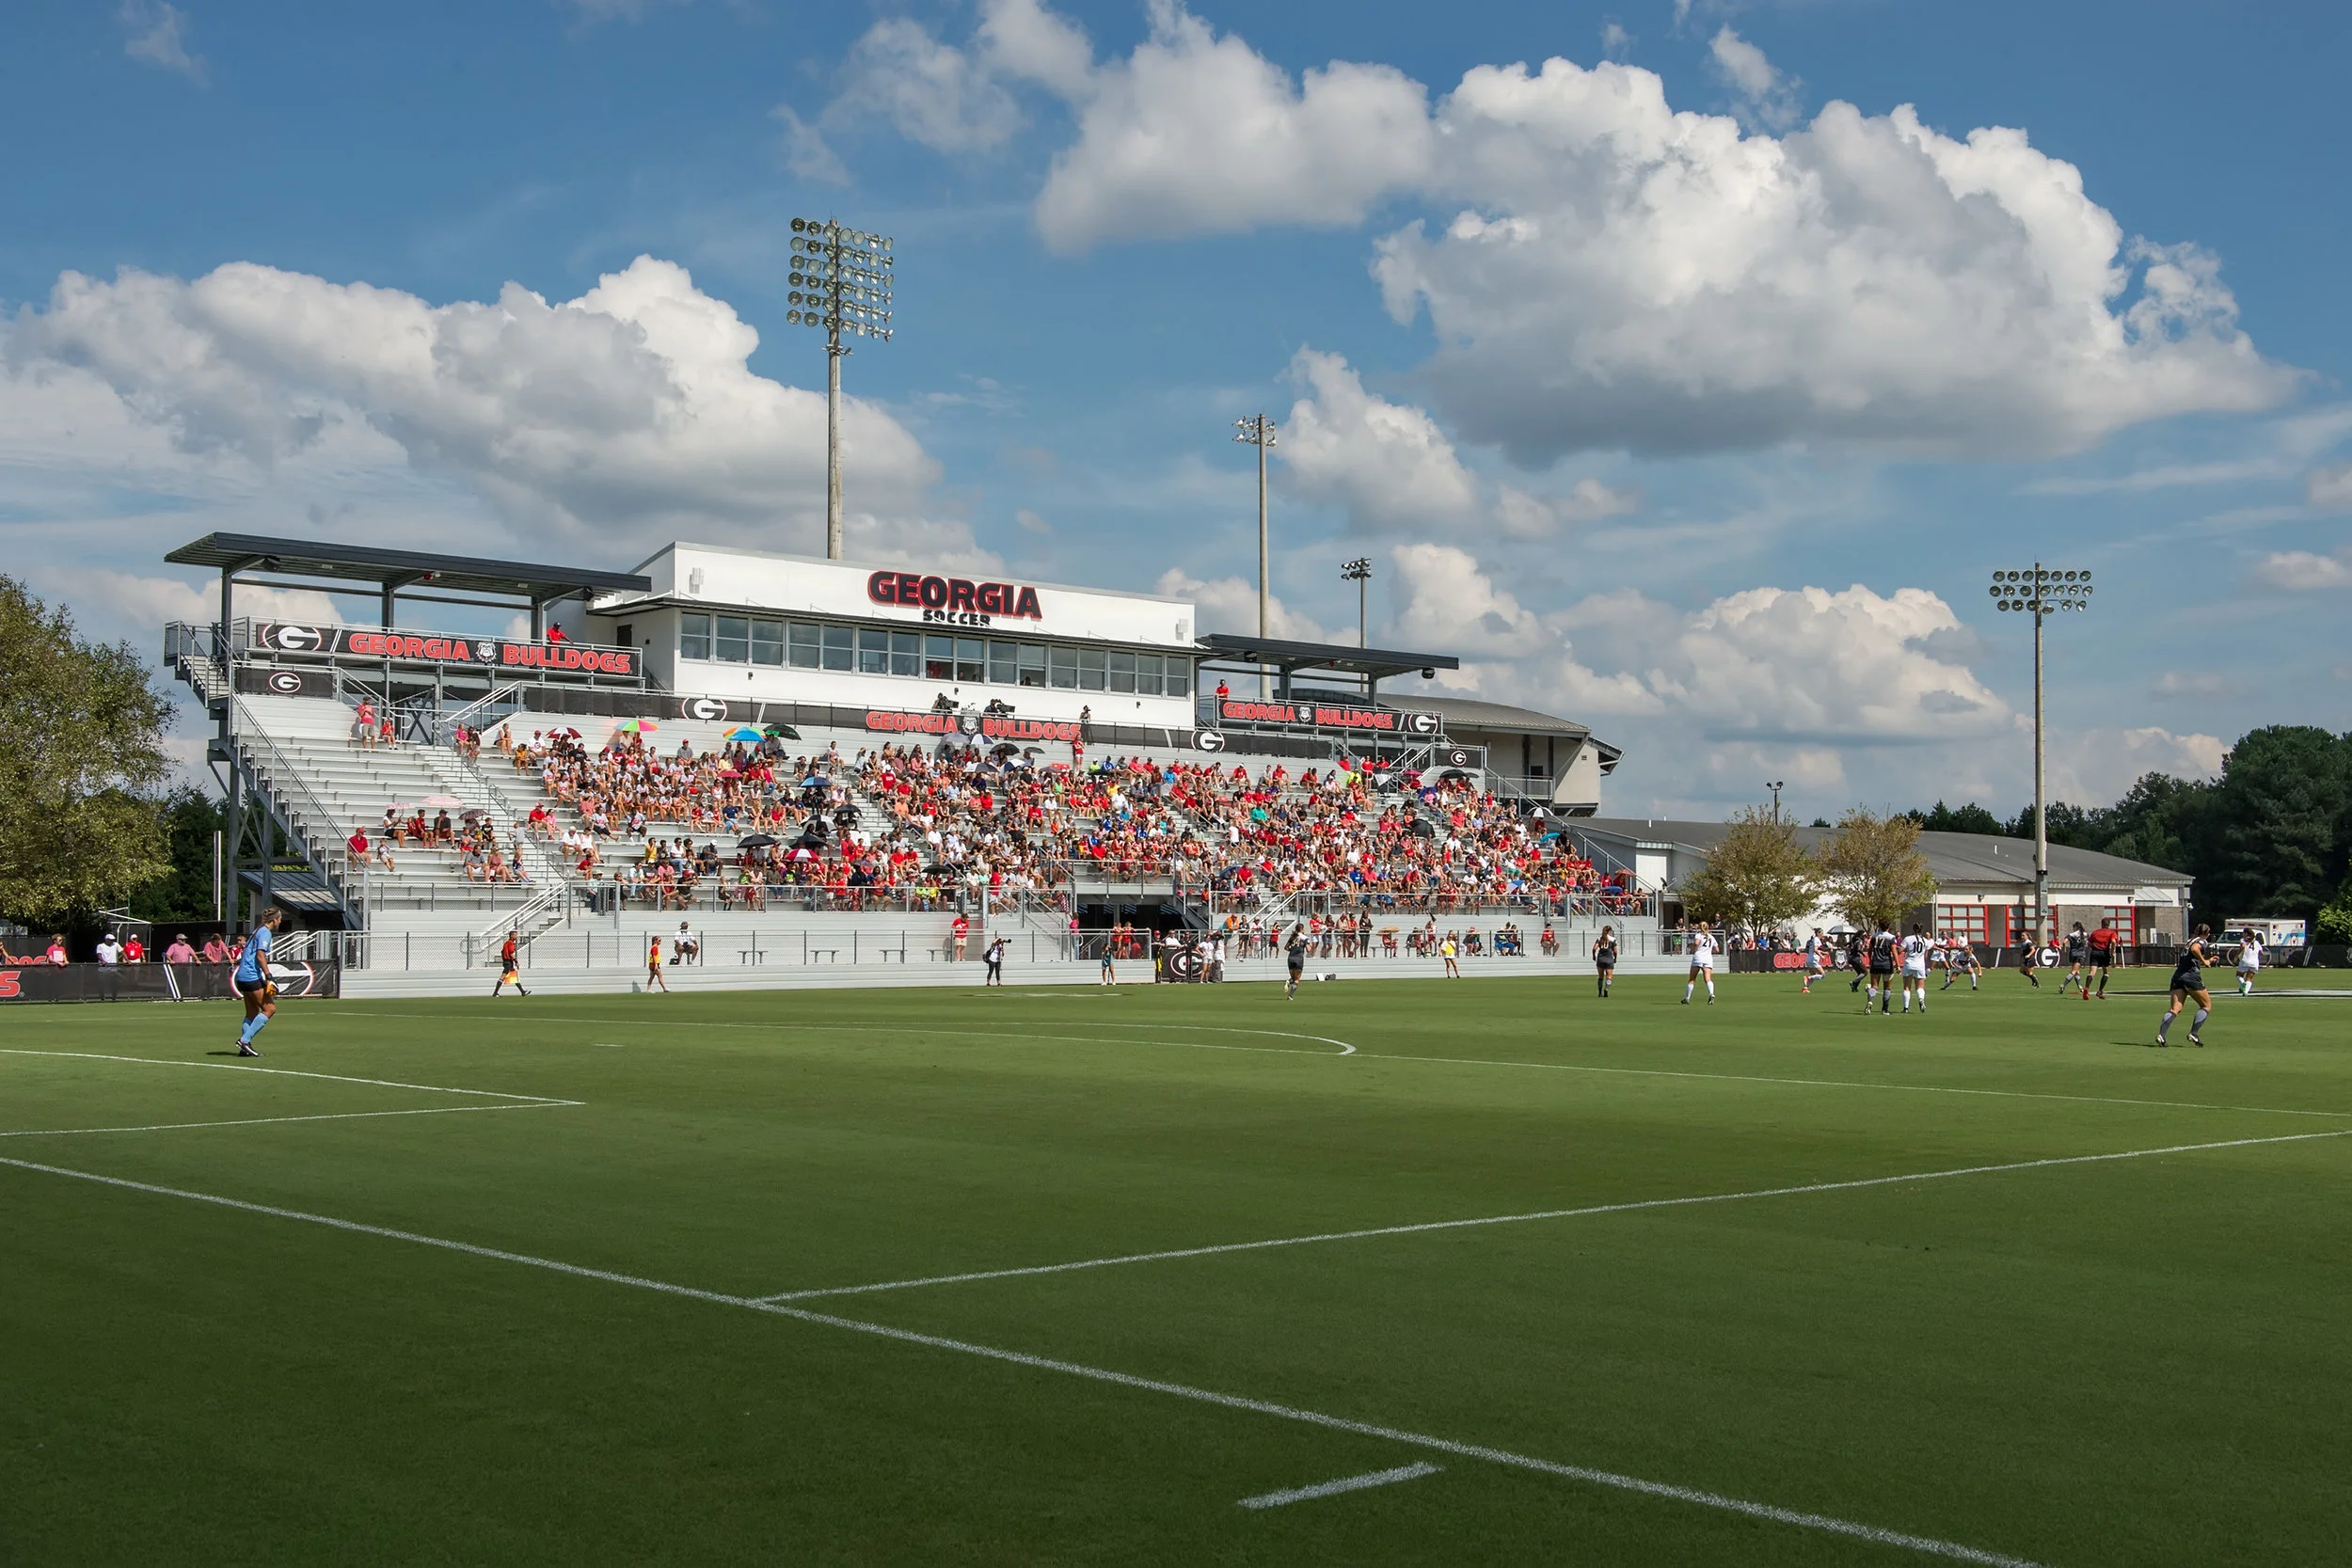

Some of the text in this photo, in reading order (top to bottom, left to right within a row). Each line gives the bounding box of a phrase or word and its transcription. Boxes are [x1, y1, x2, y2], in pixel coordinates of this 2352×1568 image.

[867, 570, 1042, 619] GEORGIA
[923, 610, 991, 627] SOCCER
[349, 632, 470, 660] GEORGIA
[503, 643, 631, 673] BULLDOGS
[866, 711, 958, 733] GEORGIA
[983, 717, 1082, 740] BULLDOGS
[1223, 702, 1296, 721] GEORGIA
[1316, 708, 1393, 729] BULLDOGS
[1703, 937, 1711, 947] 21
[1913, 941, 1923, 954] 10
[2249, 942, 2255, 952] 4
